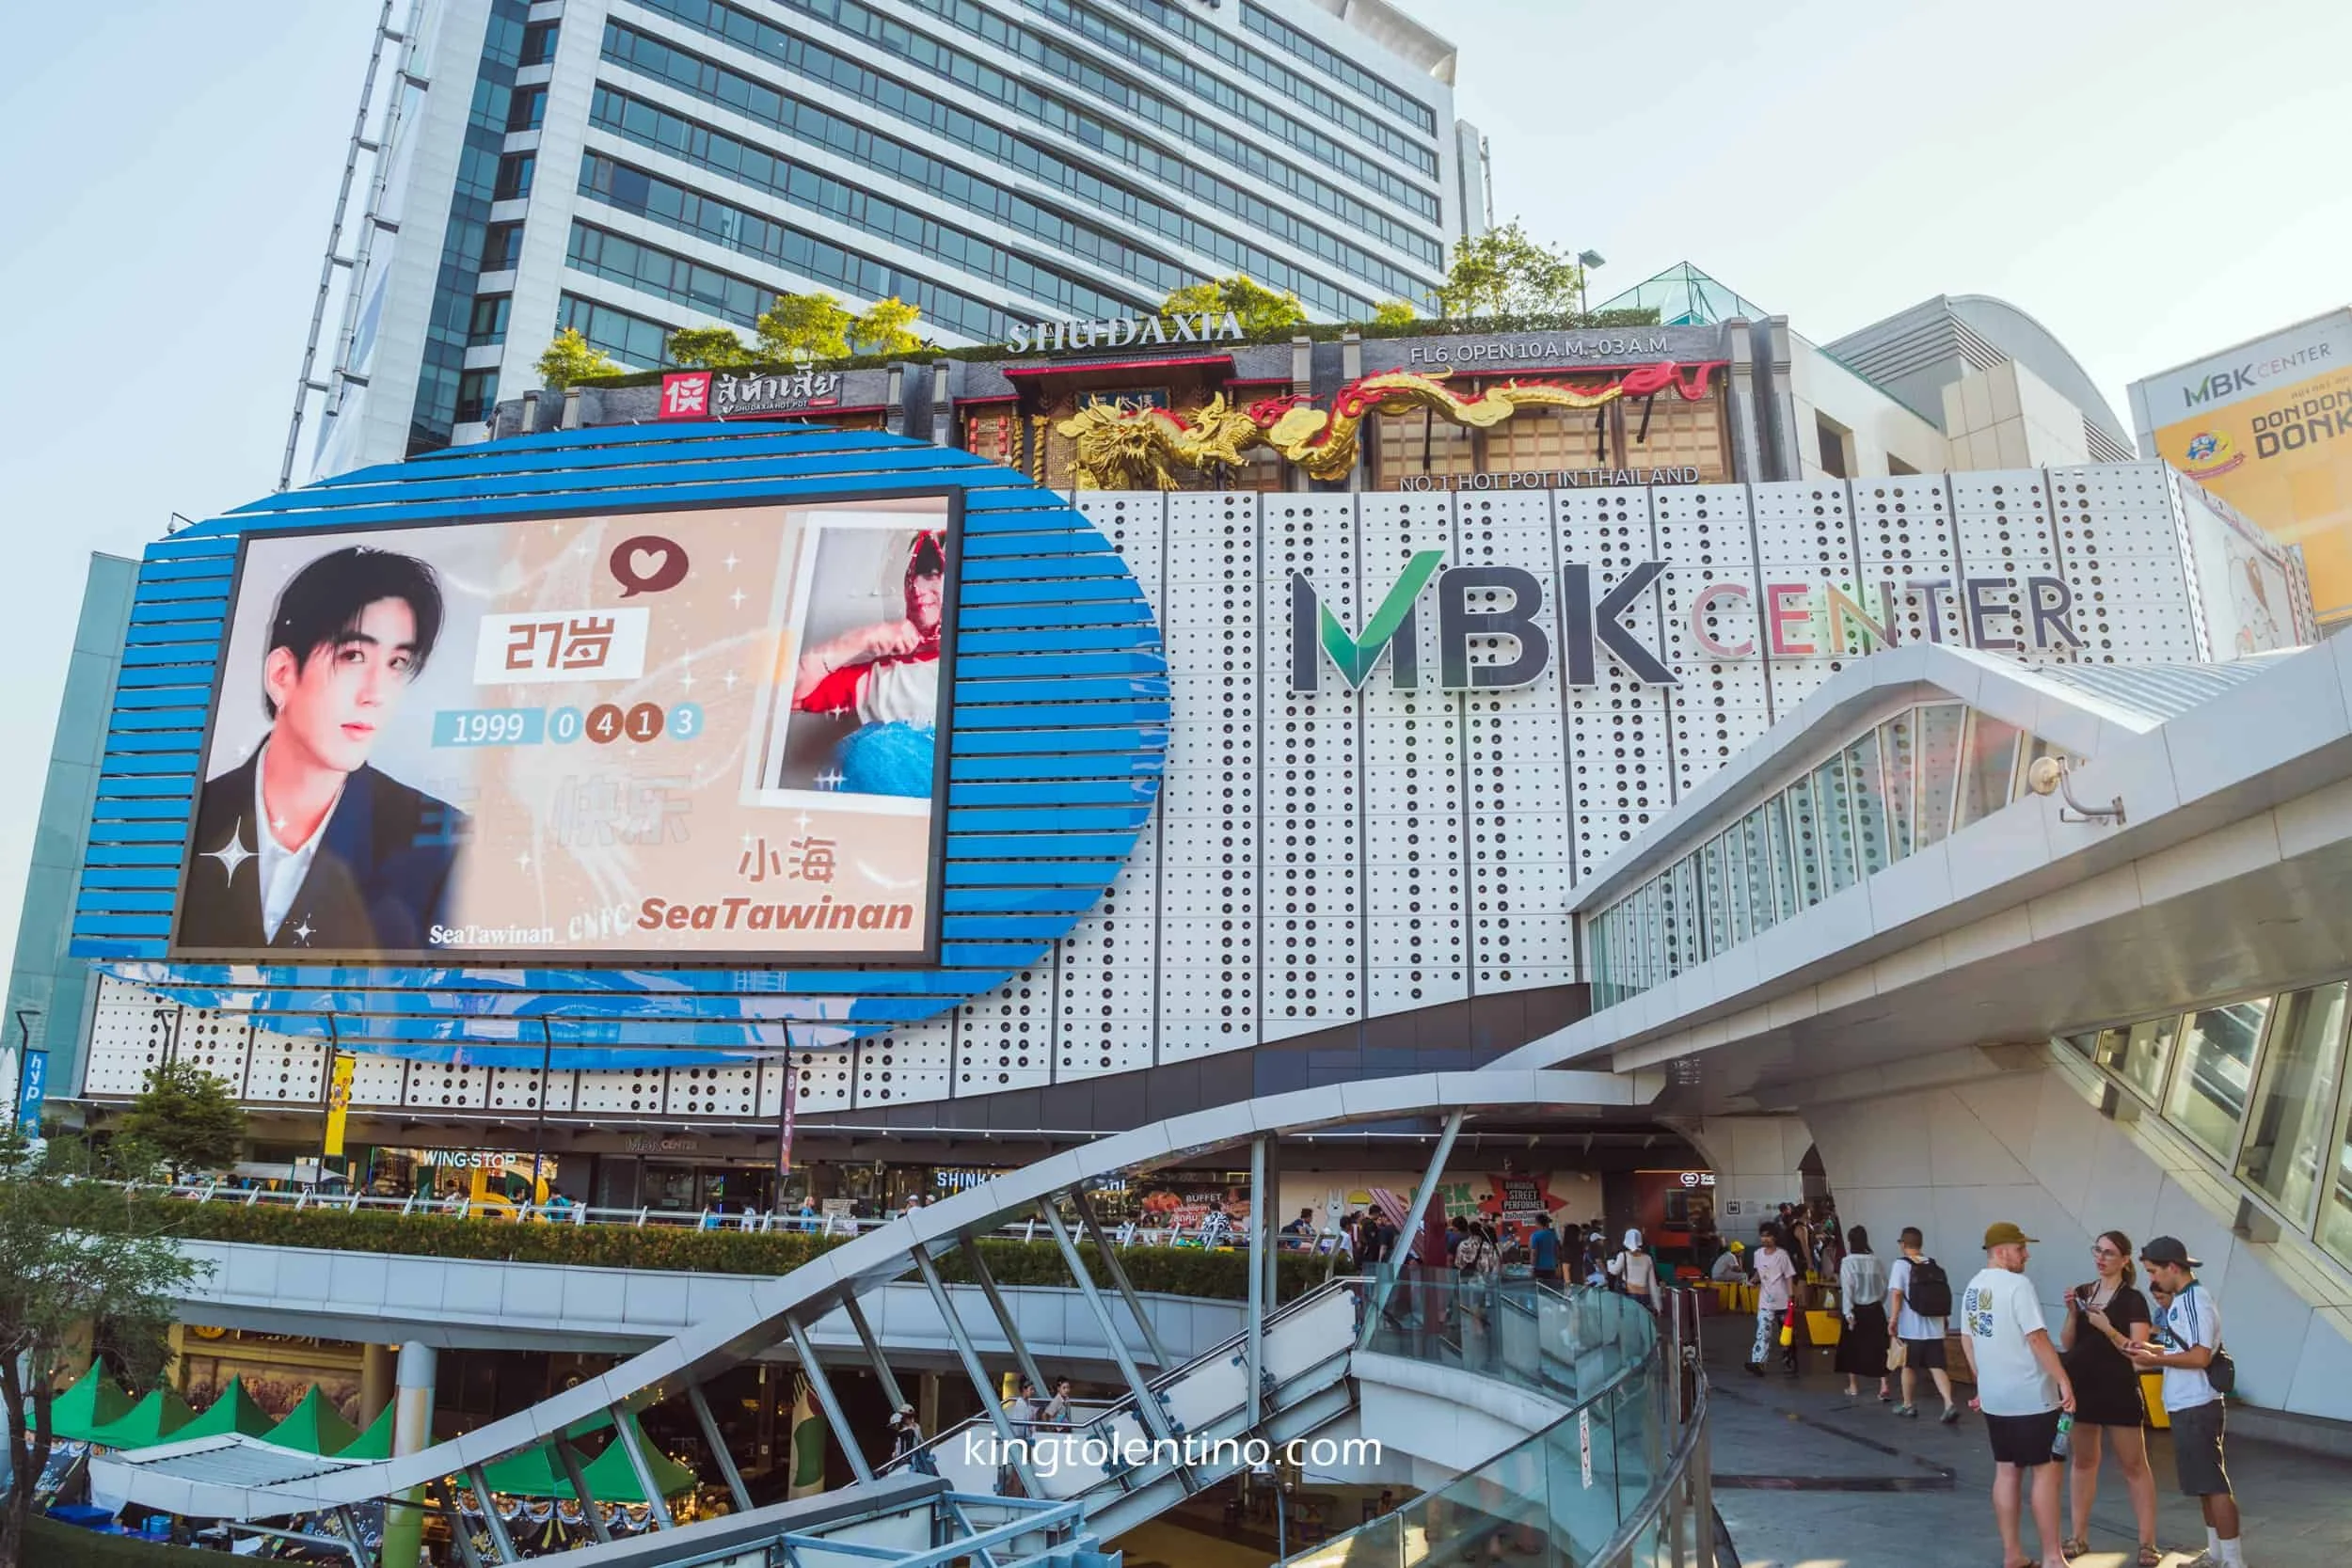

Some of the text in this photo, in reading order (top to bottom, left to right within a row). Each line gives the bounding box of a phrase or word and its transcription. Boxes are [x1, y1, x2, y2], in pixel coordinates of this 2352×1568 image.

[2182, 363, 2257, 408] MBK
[2257, 342, 2331, 378] CENTER
[2252, 404, 2301, 434] DON
[1457, 472, 1502, 491] HOT
[1508, 470, 1552, 489] POT
[1557, 469, 1579, 487] IN
[1586, 467, 1701, 487] THAILAND
[1291, 549, 2084, 692] MBK CENTER
[452, 713, 525, 743] 1999
[738, 835, 836, 884] 小海
[637, 895, 914, 930] SeaTawinan
[1185, 1193, 1223, 1203] BUFFET
[1508, 1190, 1538, 1200] STREET
